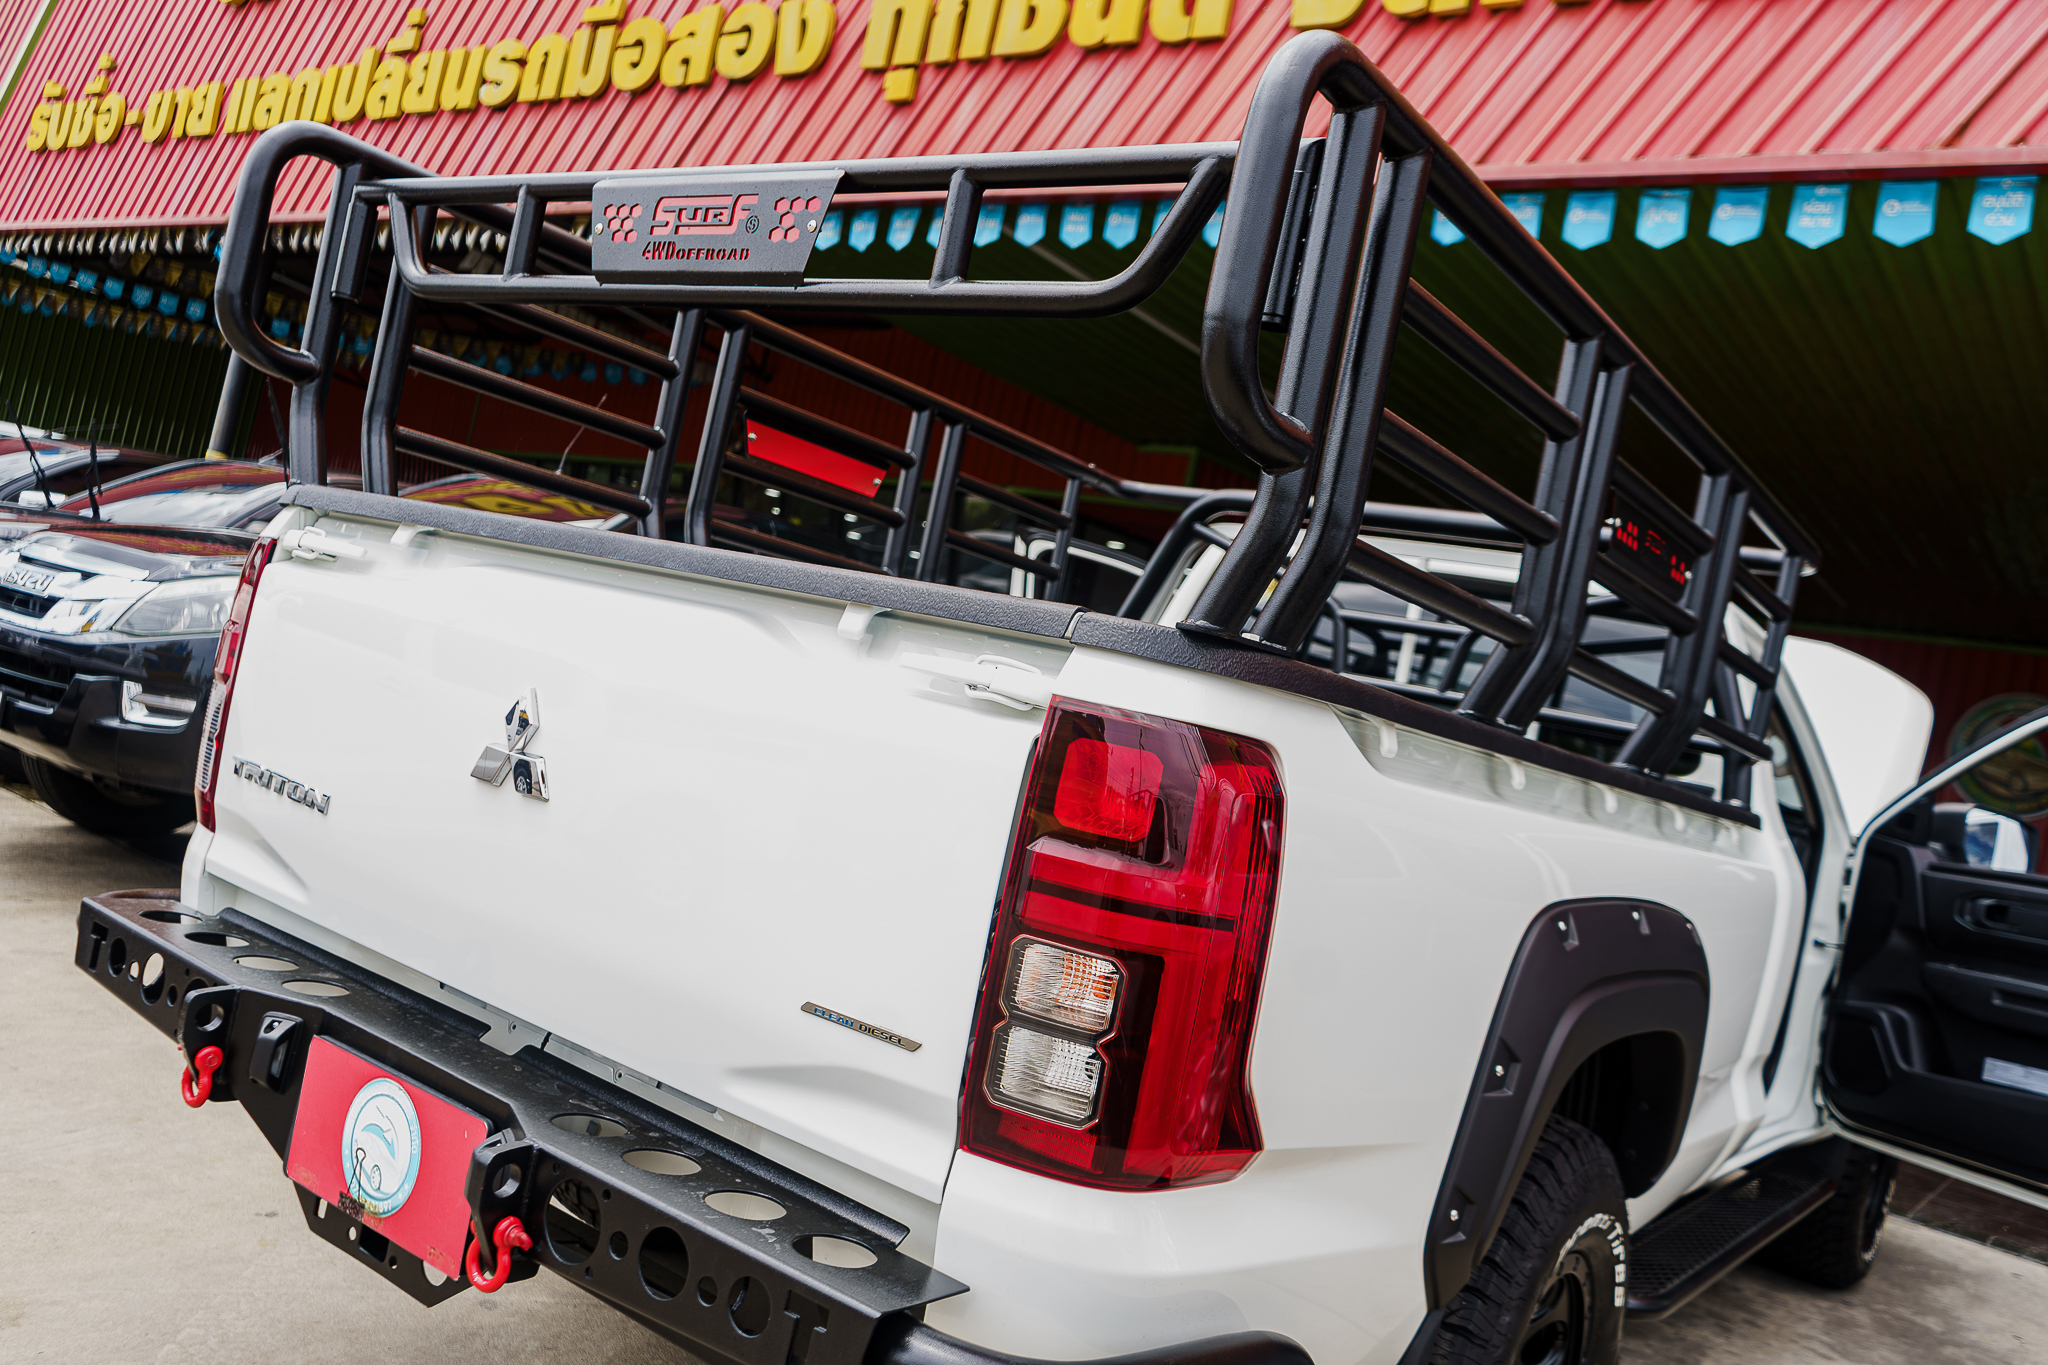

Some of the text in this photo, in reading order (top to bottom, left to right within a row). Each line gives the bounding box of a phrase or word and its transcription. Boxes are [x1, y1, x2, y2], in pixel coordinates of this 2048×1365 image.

[860, 0, 1231, 103] ทุกชน
[232, 755, 331, 816] TRITON
[813, 1006, 907, 1048] CLEAN DIESEL
